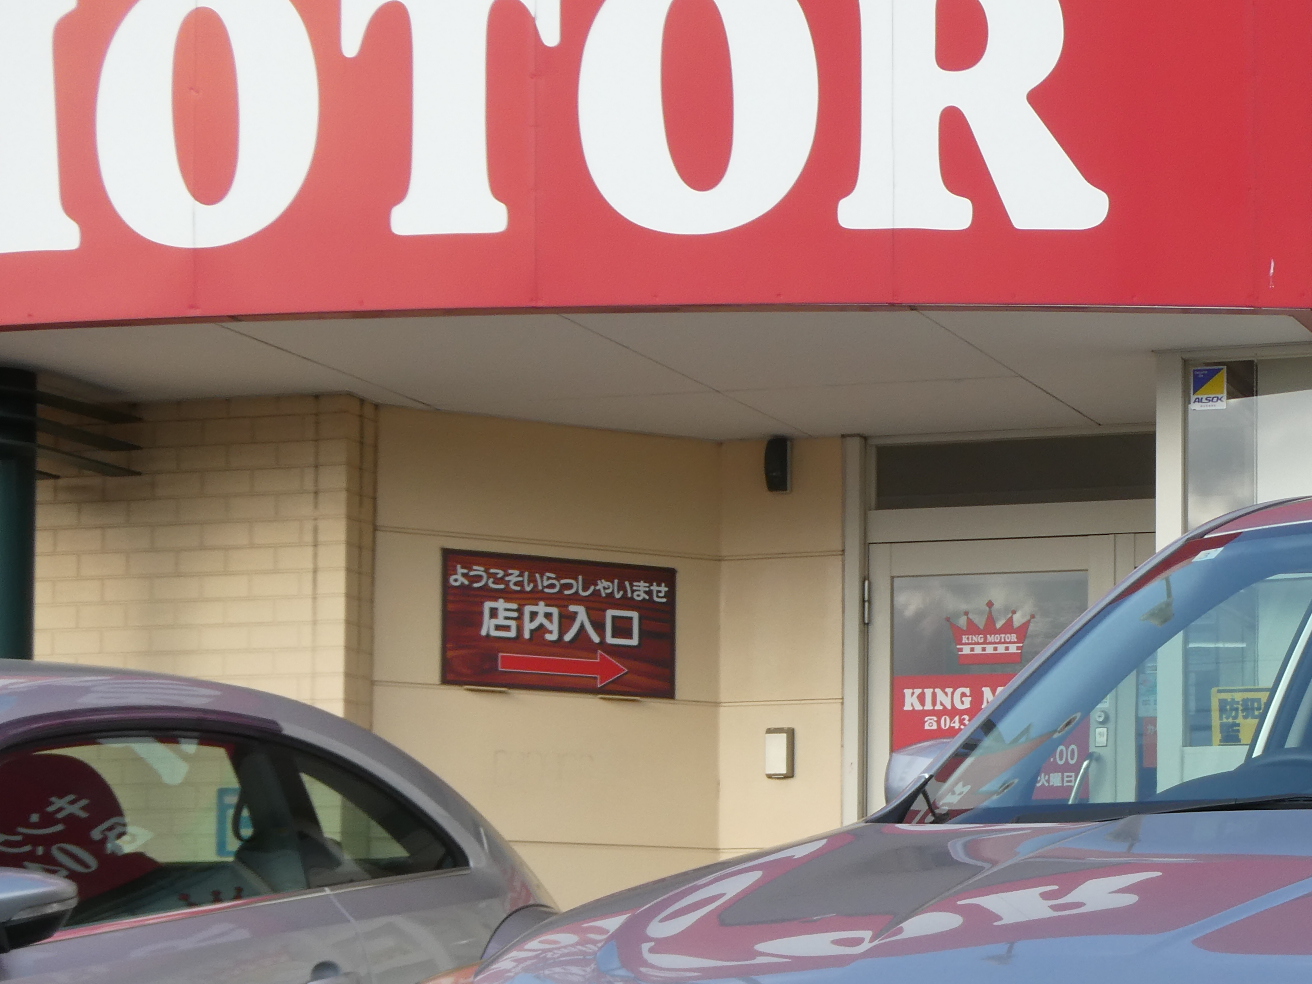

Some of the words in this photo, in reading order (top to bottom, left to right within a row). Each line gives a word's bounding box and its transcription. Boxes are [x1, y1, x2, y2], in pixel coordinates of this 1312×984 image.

[1192, 395, 1225, 404] ALSOK
[480, 598, 640, 646] 店内入口
[961, 634, 985, 644] KING
[986, 633, 1018, 643] MOTOR
[903, 687, 972, 711] KING
